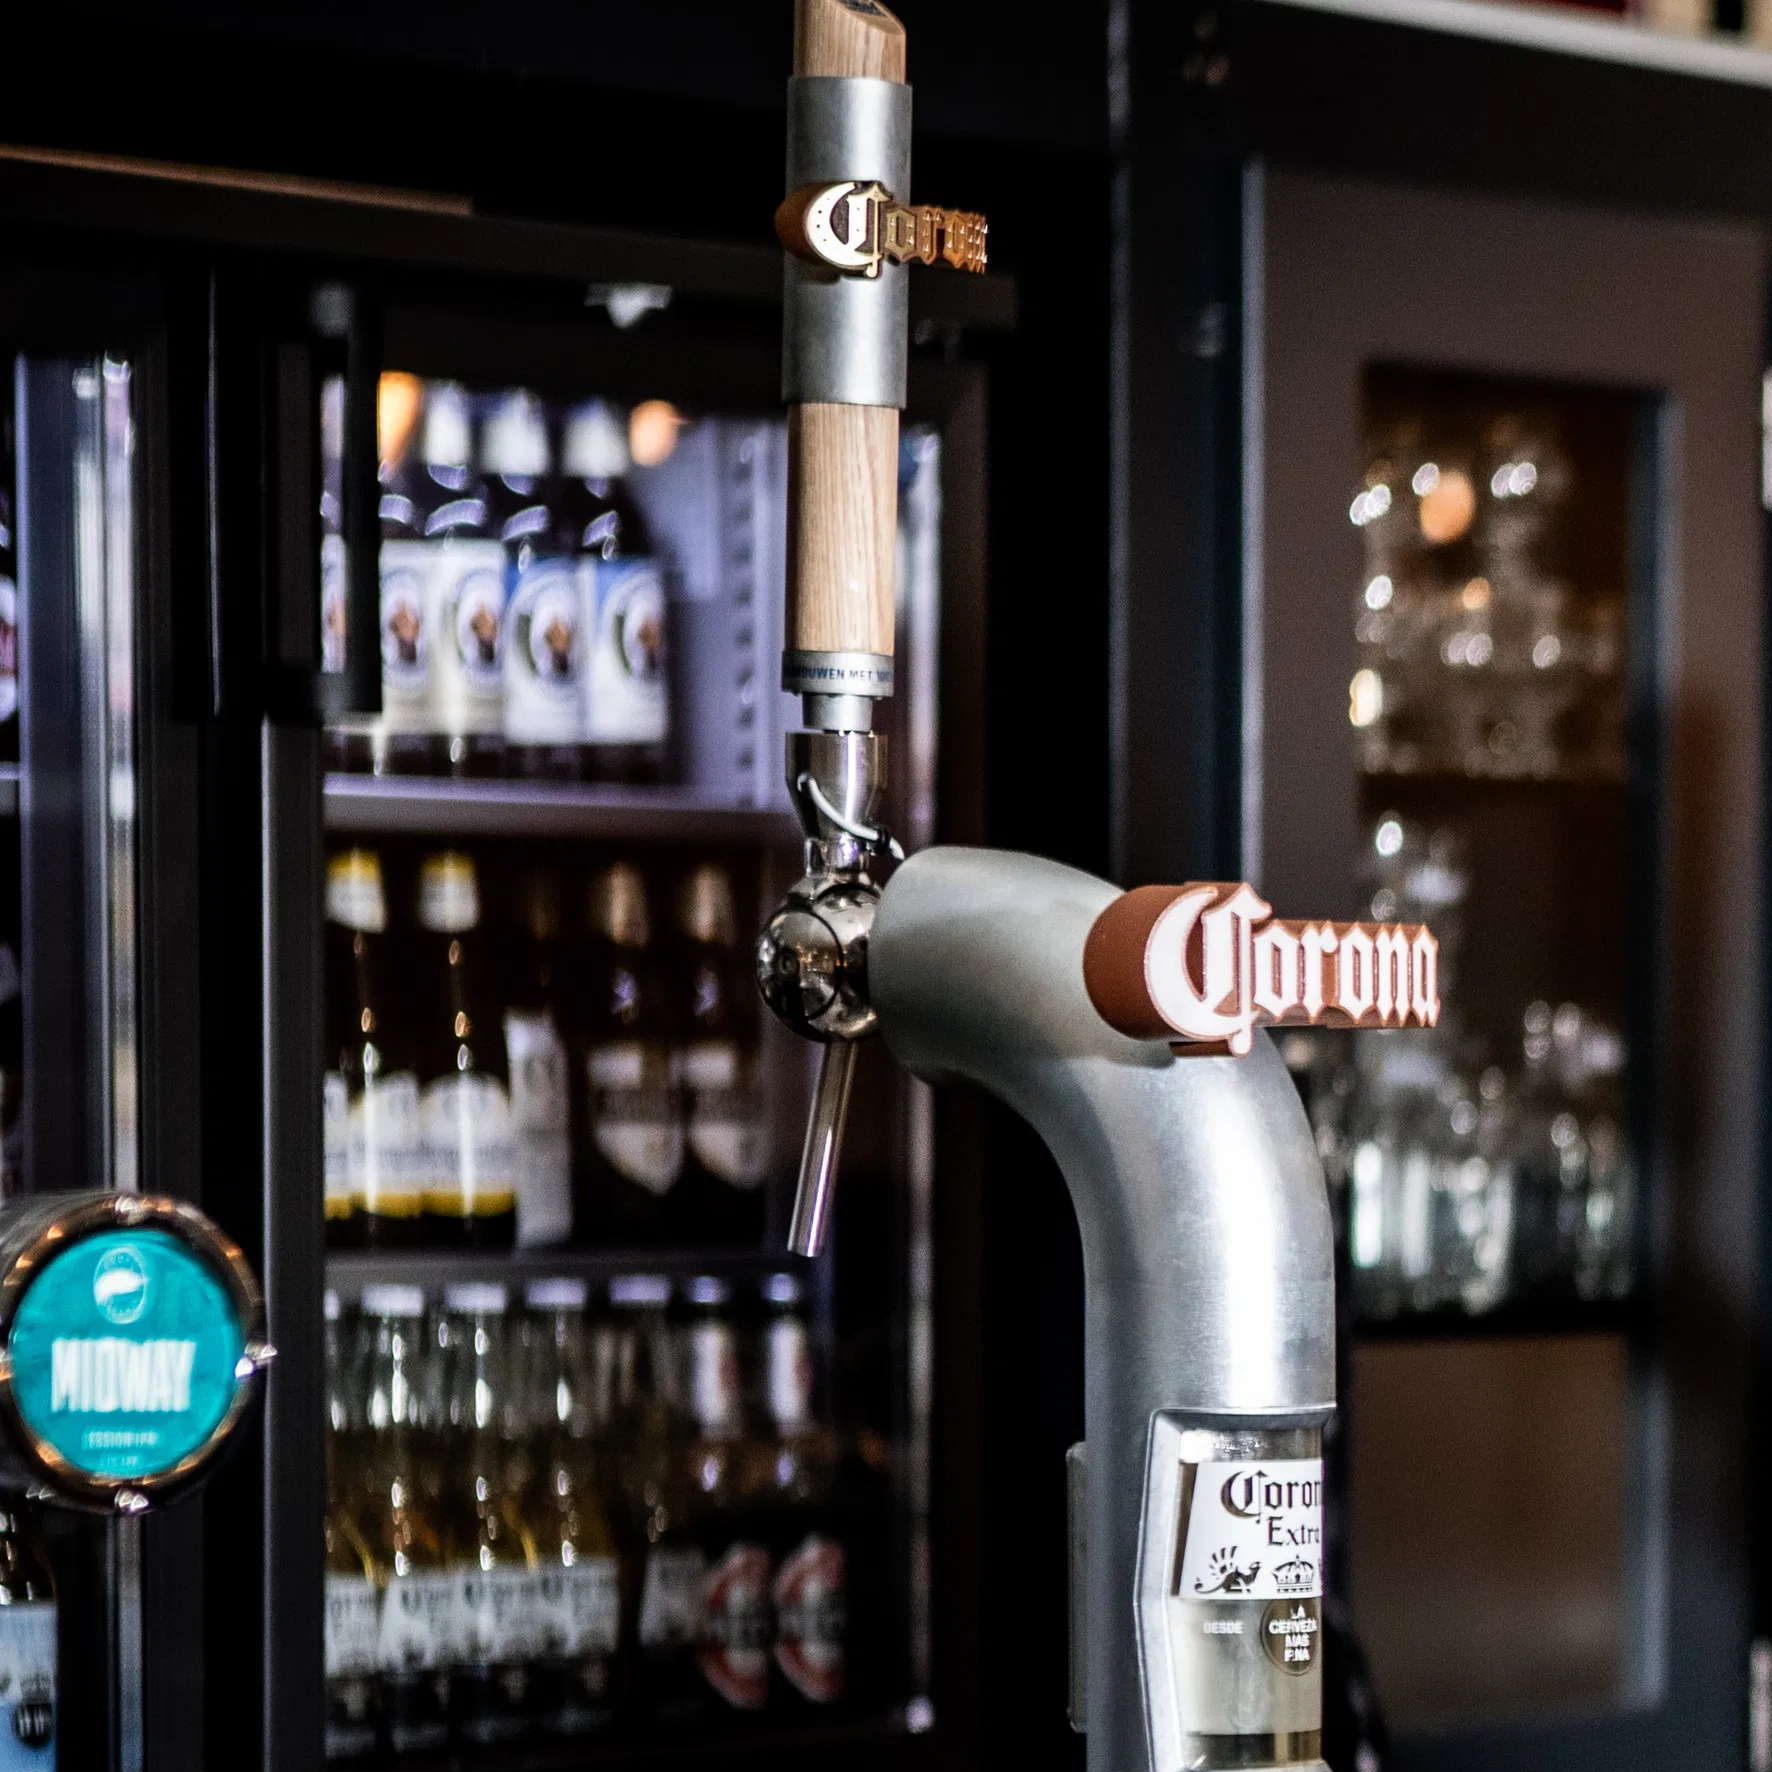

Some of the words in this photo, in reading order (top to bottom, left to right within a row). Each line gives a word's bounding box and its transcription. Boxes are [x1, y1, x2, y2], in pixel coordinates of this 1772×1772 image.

[1144, 881, 1441, 1058] Corona
[52, 1336, 196, 1413] MIDWAY
[1220, 1470, 1321, 1524] Coron
[1203, 1621, 1244, 1634] DESDE
